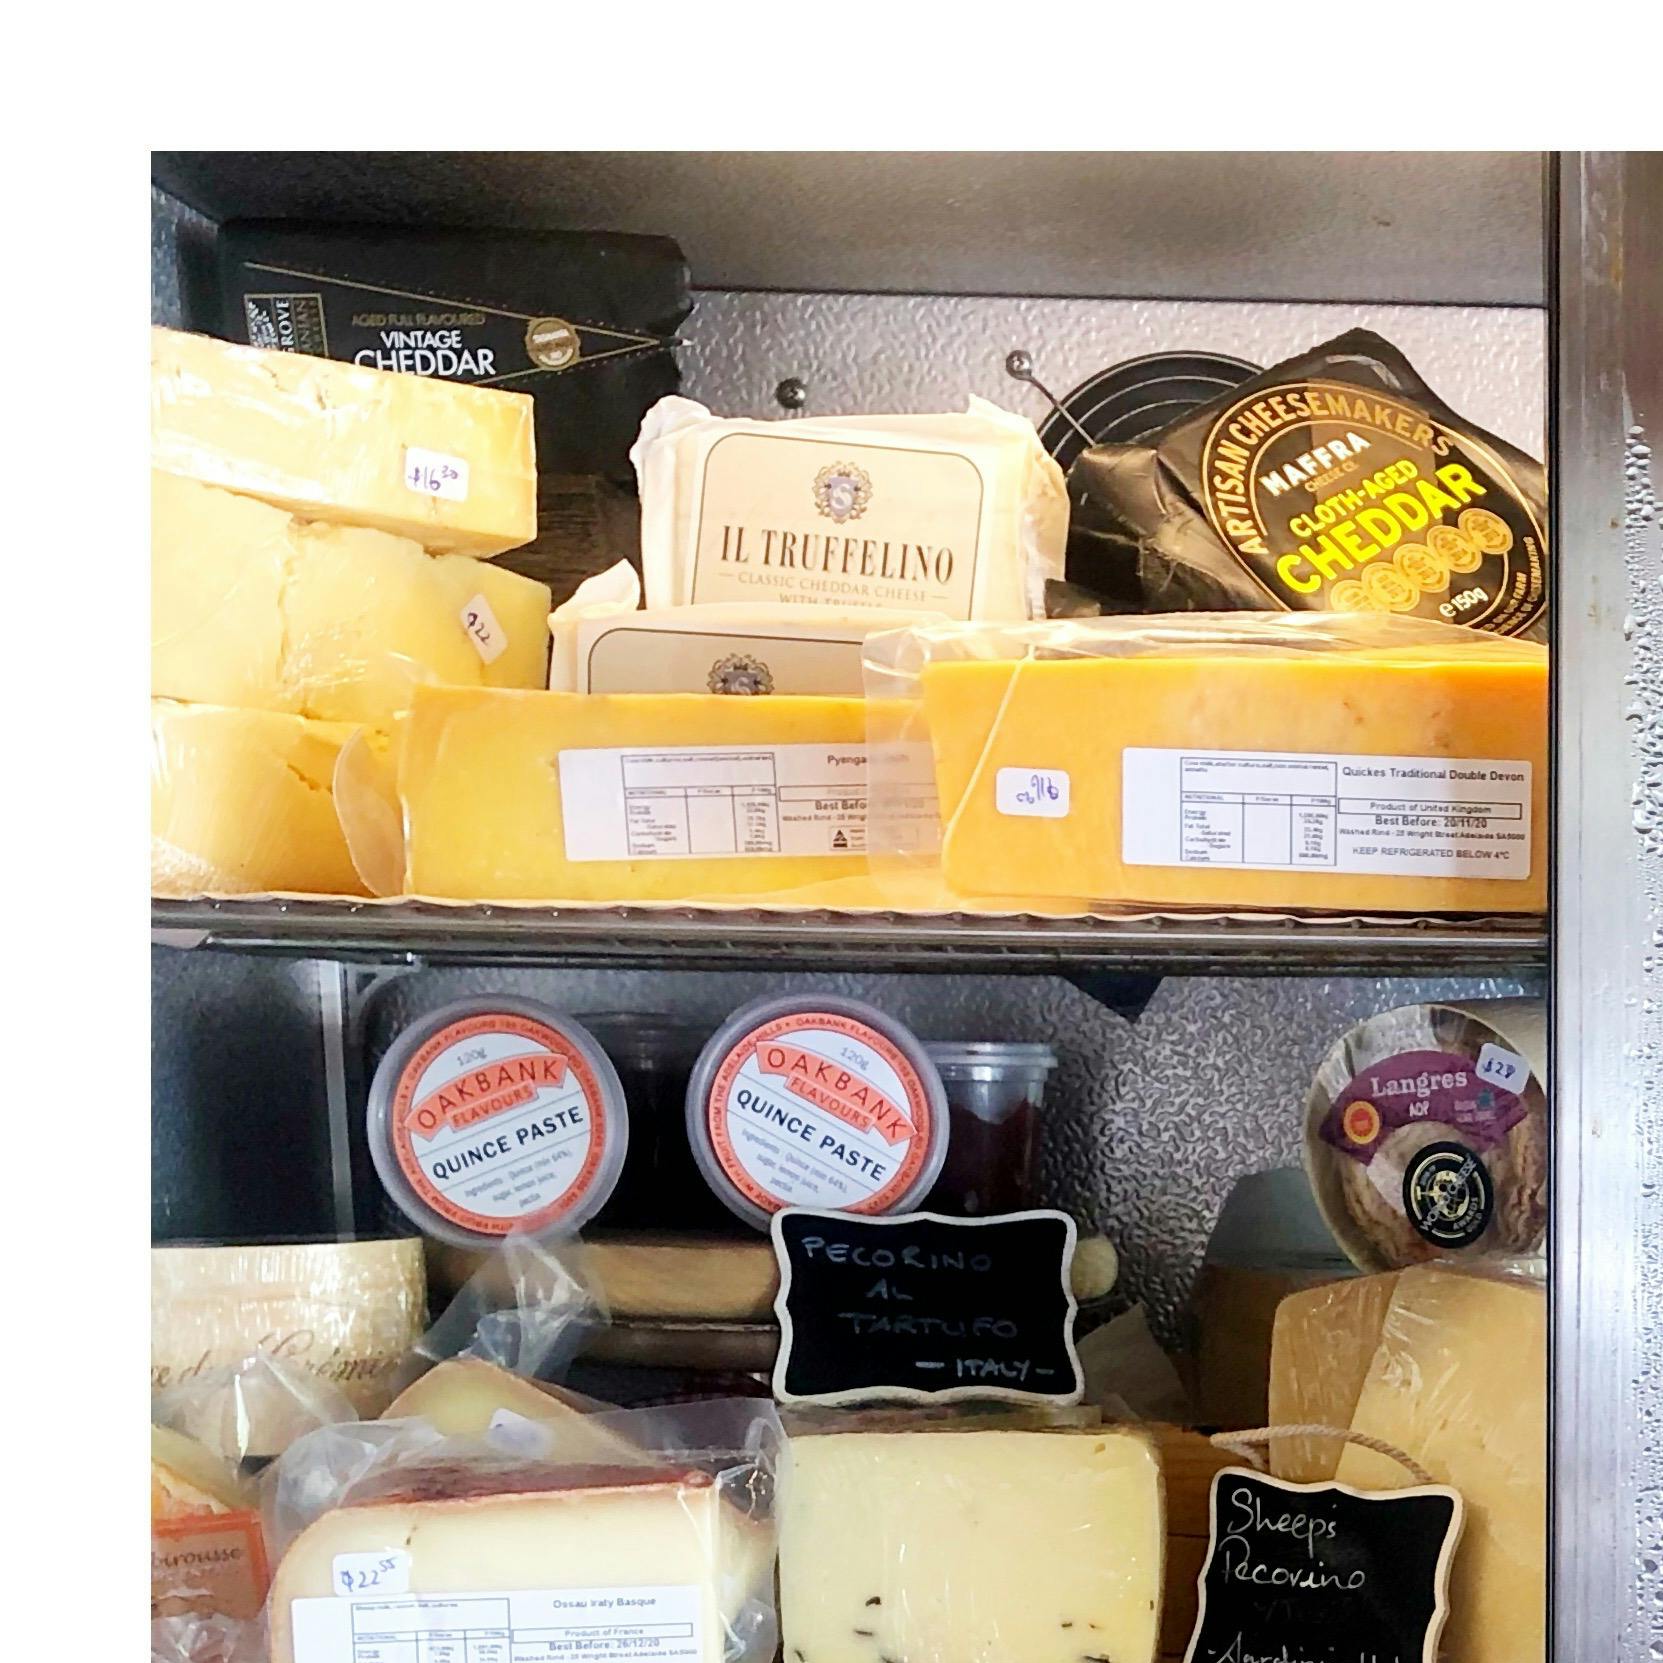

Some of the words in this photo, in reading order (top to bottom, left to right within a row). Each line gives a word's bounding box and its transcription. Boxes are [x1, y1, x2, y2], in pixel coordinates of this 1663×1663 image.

[380, 330, 463, 349] VINTAGE
[354, 350, 496, 376] CHEDDAR
[1228, 391, 1455, 457] CHEESEMAKERS
[1258, 431, 1371, 497] MAFFRA
[1213, 439, 1270, 555] ARTISAN
[1289, 459, 1419, 538] CLOTH-AGED
[1276, 463, 1488, 594] CHEDDAR
[720, 525, 750, 563] IL
[761, 528, 955, 585] TRUFFELINO
[738, 571, 795, 589] CLASSIC
[800, 574, 870, 597] CHEDDAR
[875, 584, 927, 602] CHEESE
[1342, 766, 1386, 778] Quickes
[1390, 768, 1446, 779] Traditional
[1449, 770, 1487, 781] Double
[1490, 771, 1525, 782] Devon
[1369, 802, 1406, 811] Product
[1420, 804, 1448, 812] United
[1375, 815, 1399, 826] Best
[1401, 816, 1439, 826] Before:
[1443, 818, 1487, 828] 20/11/20
[1380, 847, 1454, 857] REFRIGERATED
[1456, 849, 1492, 858] BELOW
[417, 1059, 557, 1131] OAKBANK
[767, 1048, 908, 1139] OAKBANK
[791, 1076, 869, 1128] FLAVOURS
[1370, 1071, 1468, 1098] Langres
[452, 1085, 534, 1127] FLAVOURS
[432, 1136, 512, 1180] QUINCE
[516, 1105, 583, 1146] PASTE
[737, 1089, 816, 1142] QUINCE
[819, 1134, 887, 1182] PASTE
[802, 1236, 992, 1272] PECORINO
[866, 1278, 914, 1301] AL
[837, 1312, 1018, 1338] TARTUFO
[1218, 1534, 1366, 1590] Pecorino
[552, 1599, 587, 1608] Ossau
[616, 1597, 656, 1607] Basque
[549, 1641, 573, 1651] Best
